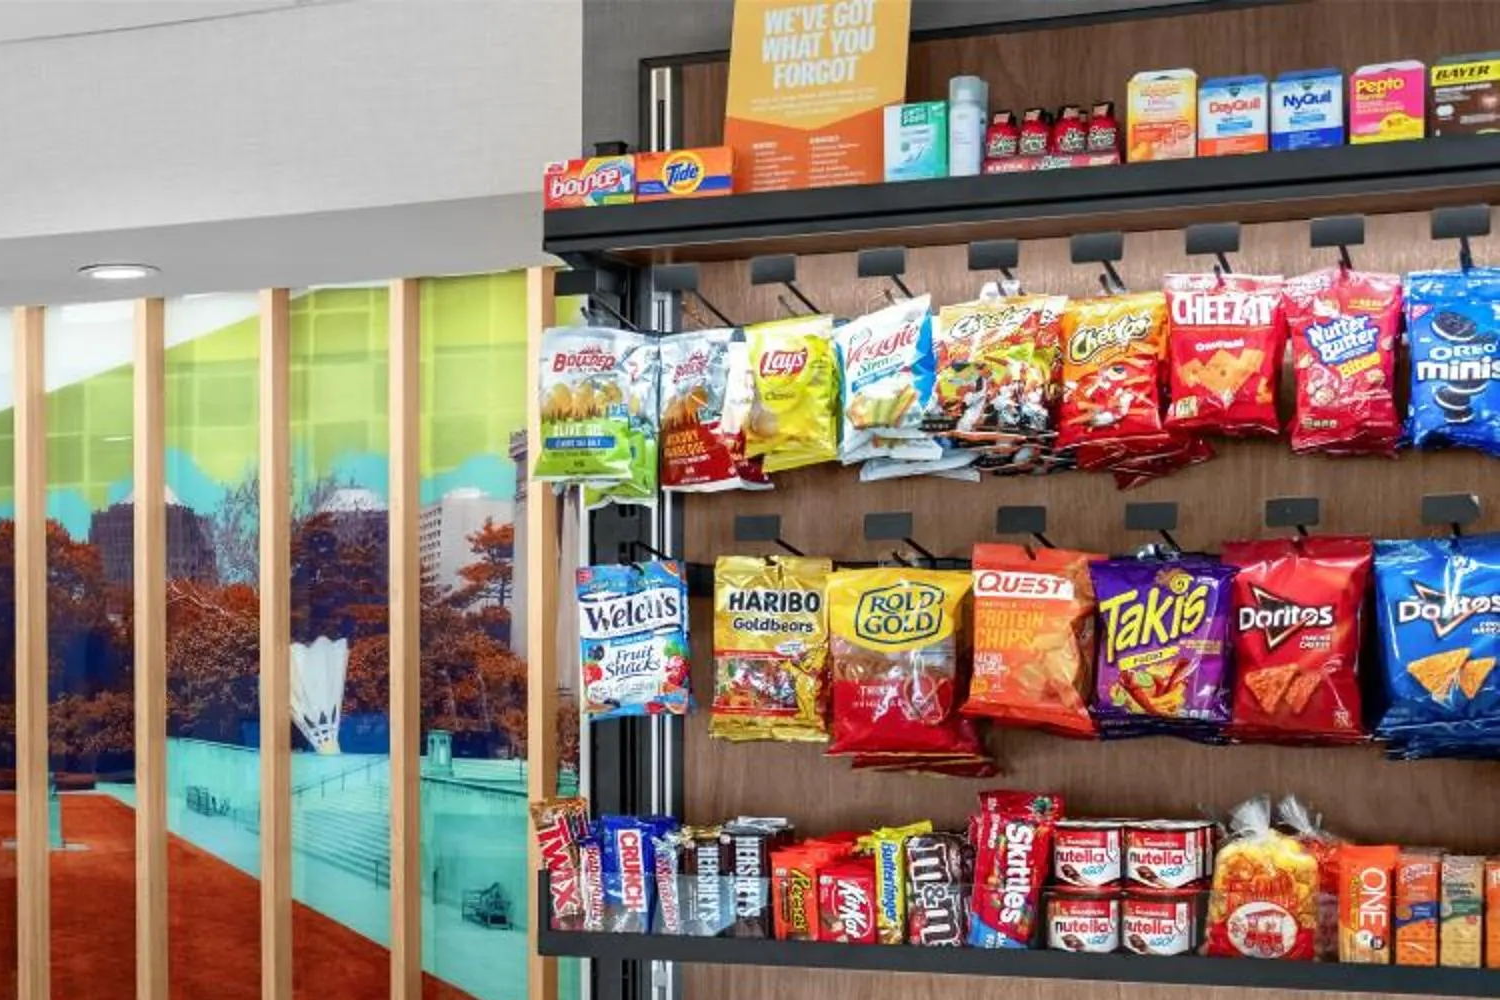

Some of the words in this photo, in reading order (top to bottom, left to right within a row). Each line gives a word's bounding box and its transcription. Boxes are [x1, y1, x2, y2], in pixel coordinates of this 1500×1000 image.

[764, 3, 830, 35] WE'VE
[833, 0, 875, 27] GOT
[762, 31, 824, 63] WHAT
[831, 26, 876, 56] YOU
[773, 56, 860, 90] FORGOT
[1283, 89, 1332, 109] NyQuil
[1355, 77, 1405, 98] Pepto
[1209, 97, 1261, 115] DayQuil
[551, 168, 621, 199] bounce
[666, 161, 699, 187] Tide
[1068, 313, 1151, 364] Cheetos
[1307, 315, 1369, 347] Nutter
[847, 323, 918, 370] Veggie
[1318, 327, 1378, 363] Butter
[1429, 343, 1497, 361] OREO
[1417, 355, 1500, 381] minis
[978, 572, 1065, 595] QUEST
[728, 590, 820, 613] HARIBO
[870, 590, 936, 613] ROLD
[732, 616, 814, 635] Goldbears
[863, 611, 934, 636] GOLD
[1100, 585, 1208, 663] Takis
[1238, 605, 1334, 631] Doritos
[617, 645, 654, 665] Fruit
[536, 814, 579, 914] TWIX
[1055, 850, 1105, 862] nutella
[1129, 850, 1183, 865] nutella
[619, 832, 644, 909] CRUNCH
[1002, 823, 1035, 925] Skittles
[1361, 867, 1388, 928] ONE
[1055, 920, 1108, 933] nutella
[1124, 919, 1173, 934] nutella
